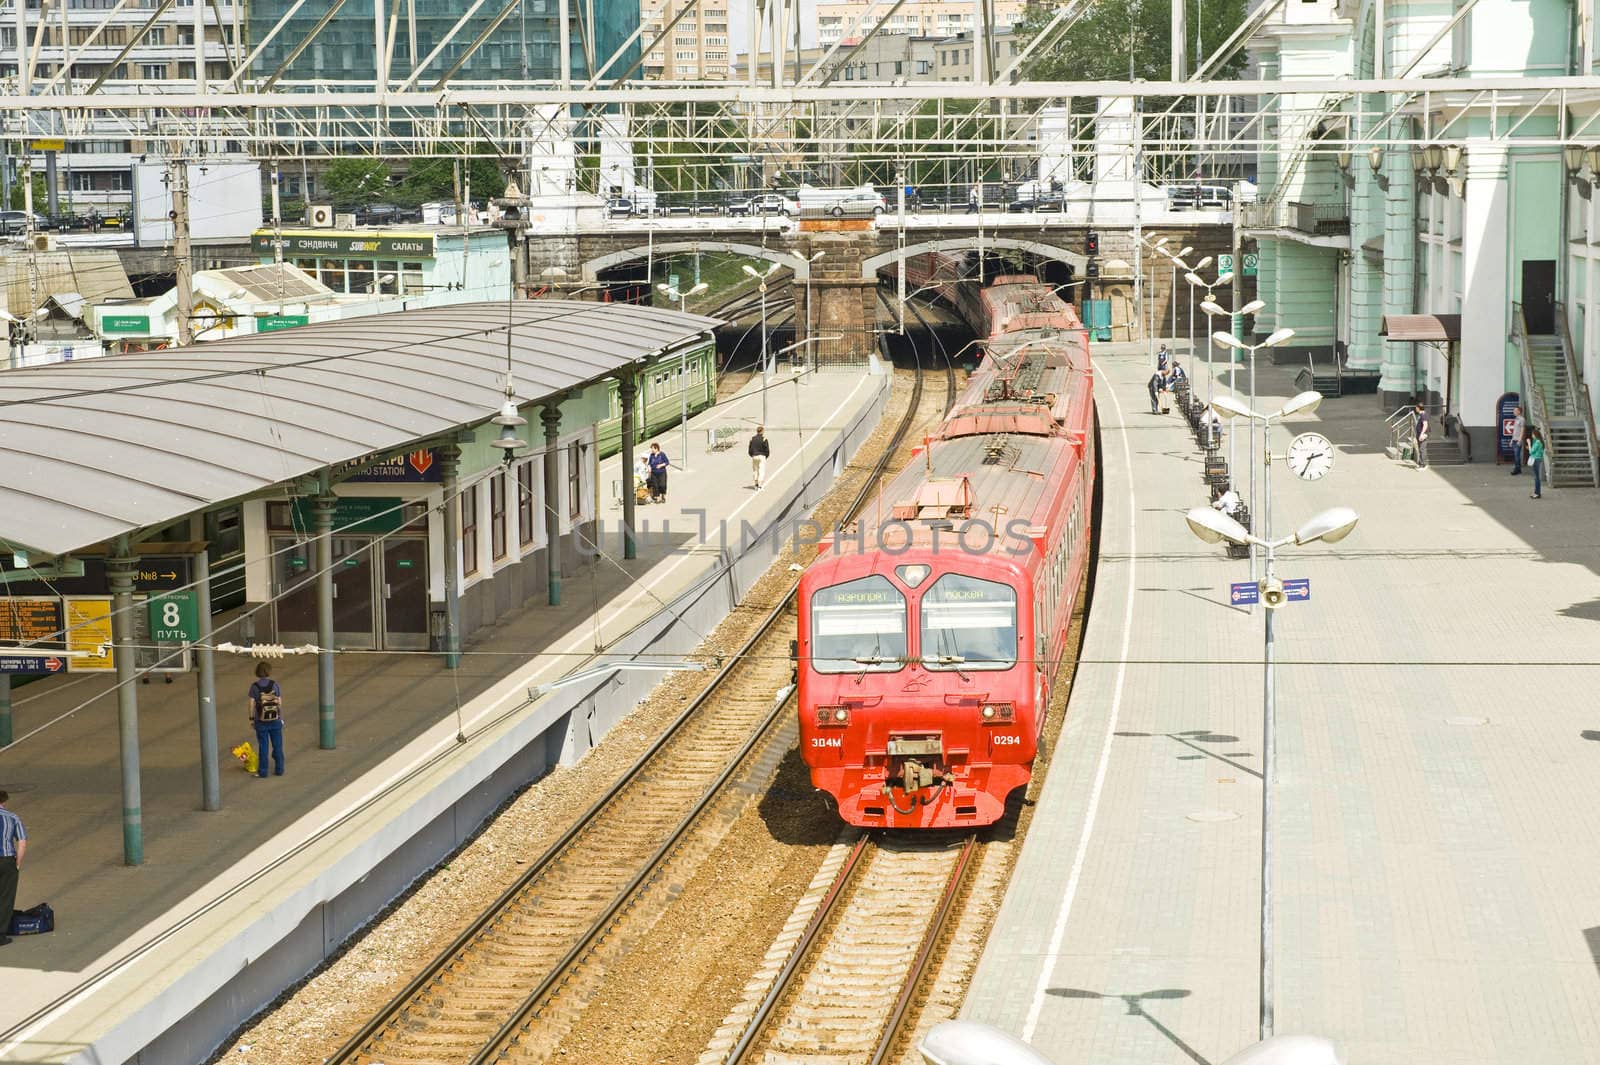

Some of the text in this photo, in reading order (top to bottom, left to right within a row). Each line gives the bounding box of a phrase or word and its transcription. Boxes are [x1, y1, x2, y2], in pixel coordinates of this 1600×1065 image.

[269, 239, 291, 248] PSI
[298, 239, 338, 250] СЭНДВИЧИ
[349, 241, 381, 252] SUBWAY
[391, 242, 423, 252] САЛАТЫ
[373, 466, 405, 476] STATION
[163, 602, 180, 627] 8
[157, 630, 187, 639] ПУТЬ
[993, 735, 1020, 745] 0294
